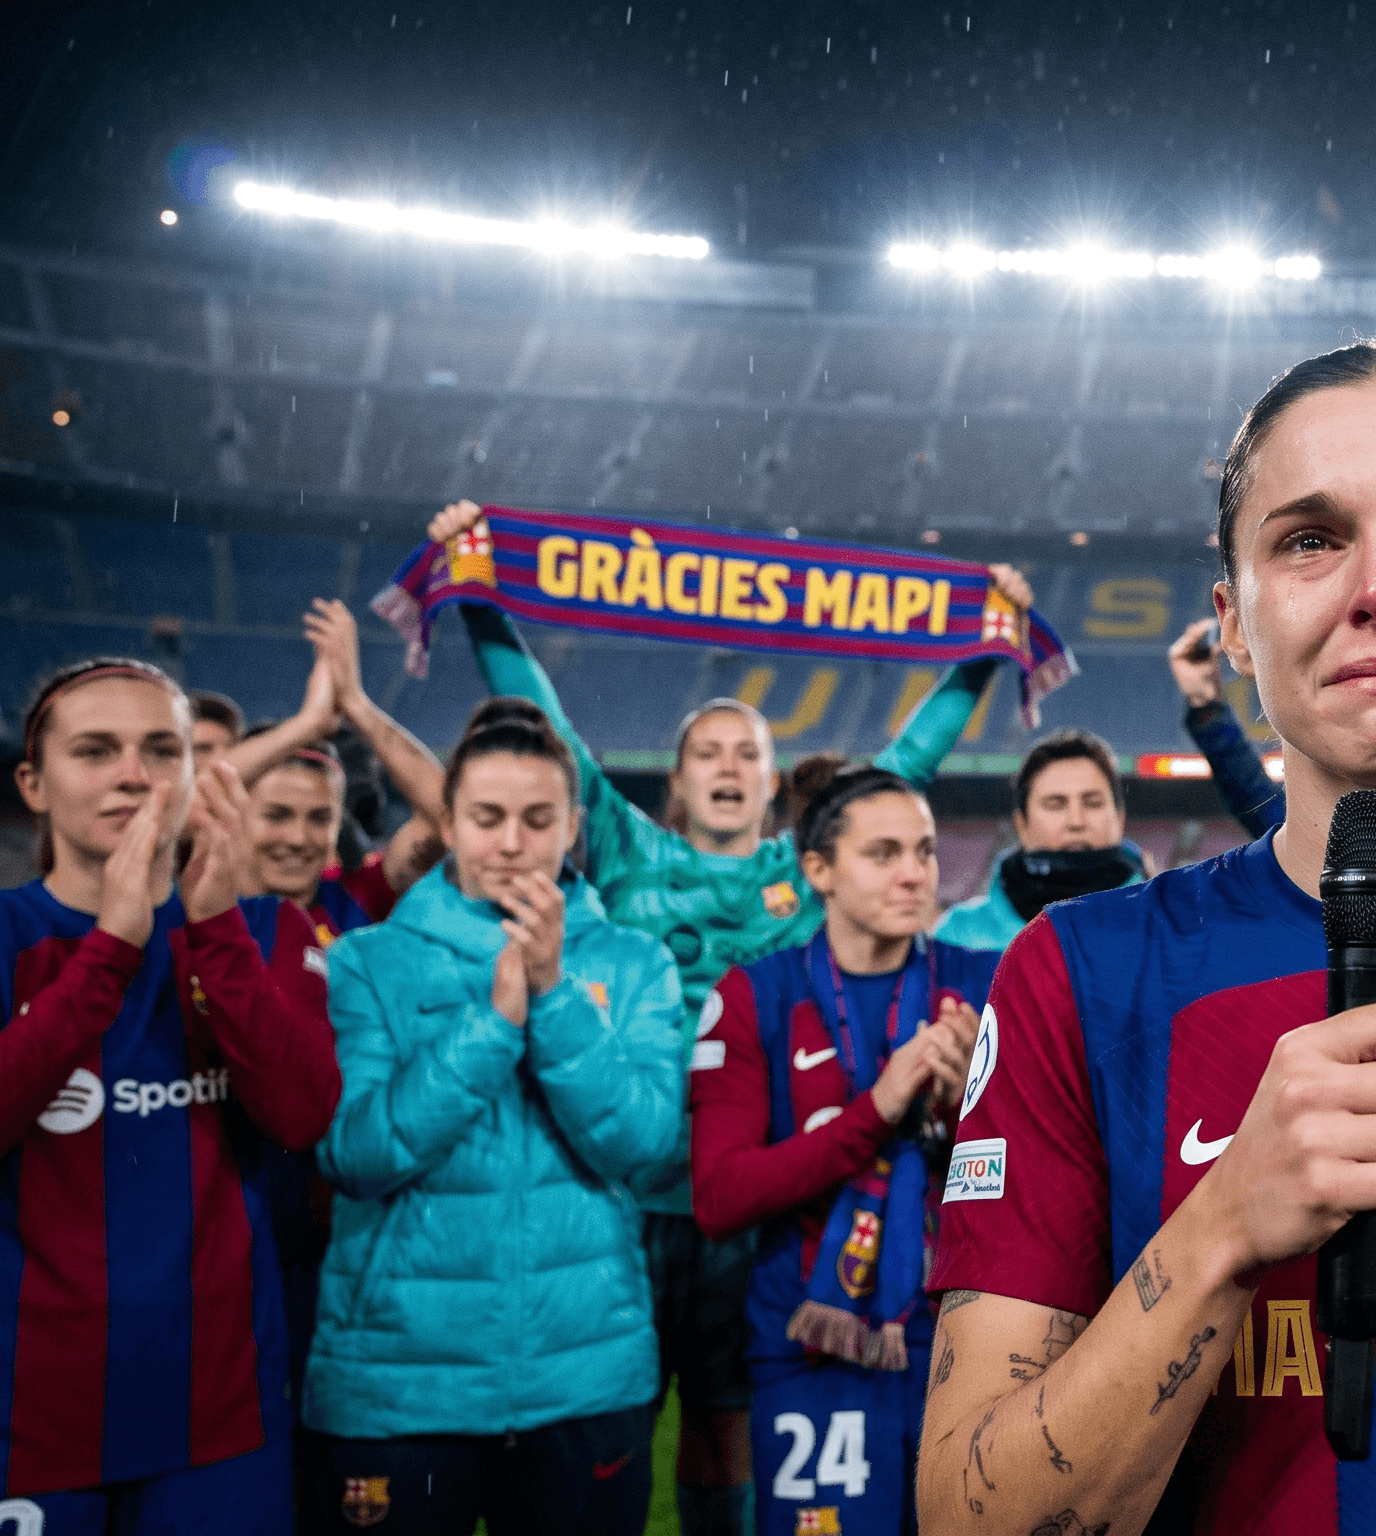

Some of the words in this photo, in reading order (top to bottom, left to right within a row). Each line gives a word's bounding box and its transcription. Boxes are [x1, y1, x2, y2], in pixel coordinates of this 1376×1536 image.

[537, 528, 791, 624] GRÀCIES
[803, 567, 951, 636] MAPI
[772, 1410, 872, 1500] 24
